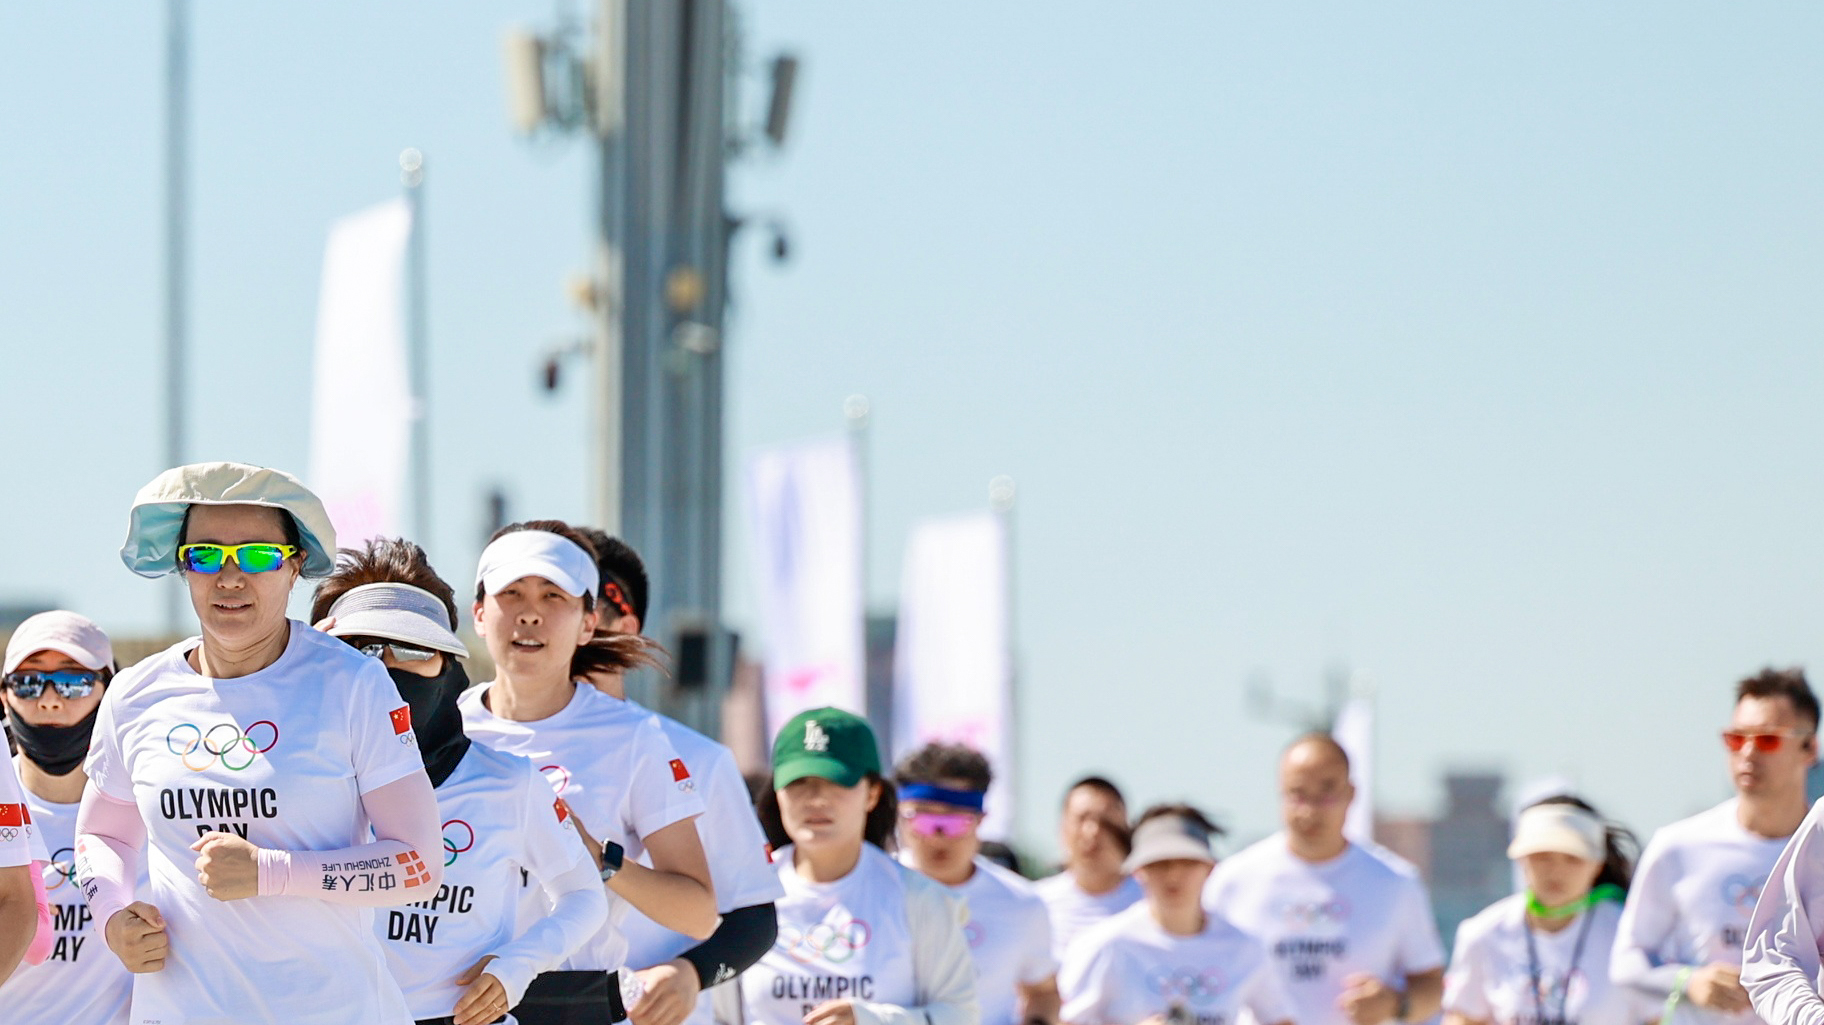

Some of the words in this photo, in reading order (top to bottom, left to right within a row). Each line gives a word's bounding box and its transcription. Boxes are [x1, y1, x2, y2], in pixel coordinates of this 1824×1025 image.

[160, 788, 277, 819] OLYMPIC
[322, 863, 342, 872] LIFE
[344, 857, 391, 872] ZHONGHUI
[322, 872, 396, 892] 中汇人寿
[387, 910, 439, 944] DAY
[45, 936, 85, 962] AY
[772, 975, 875, 1000] OLYMPIC
